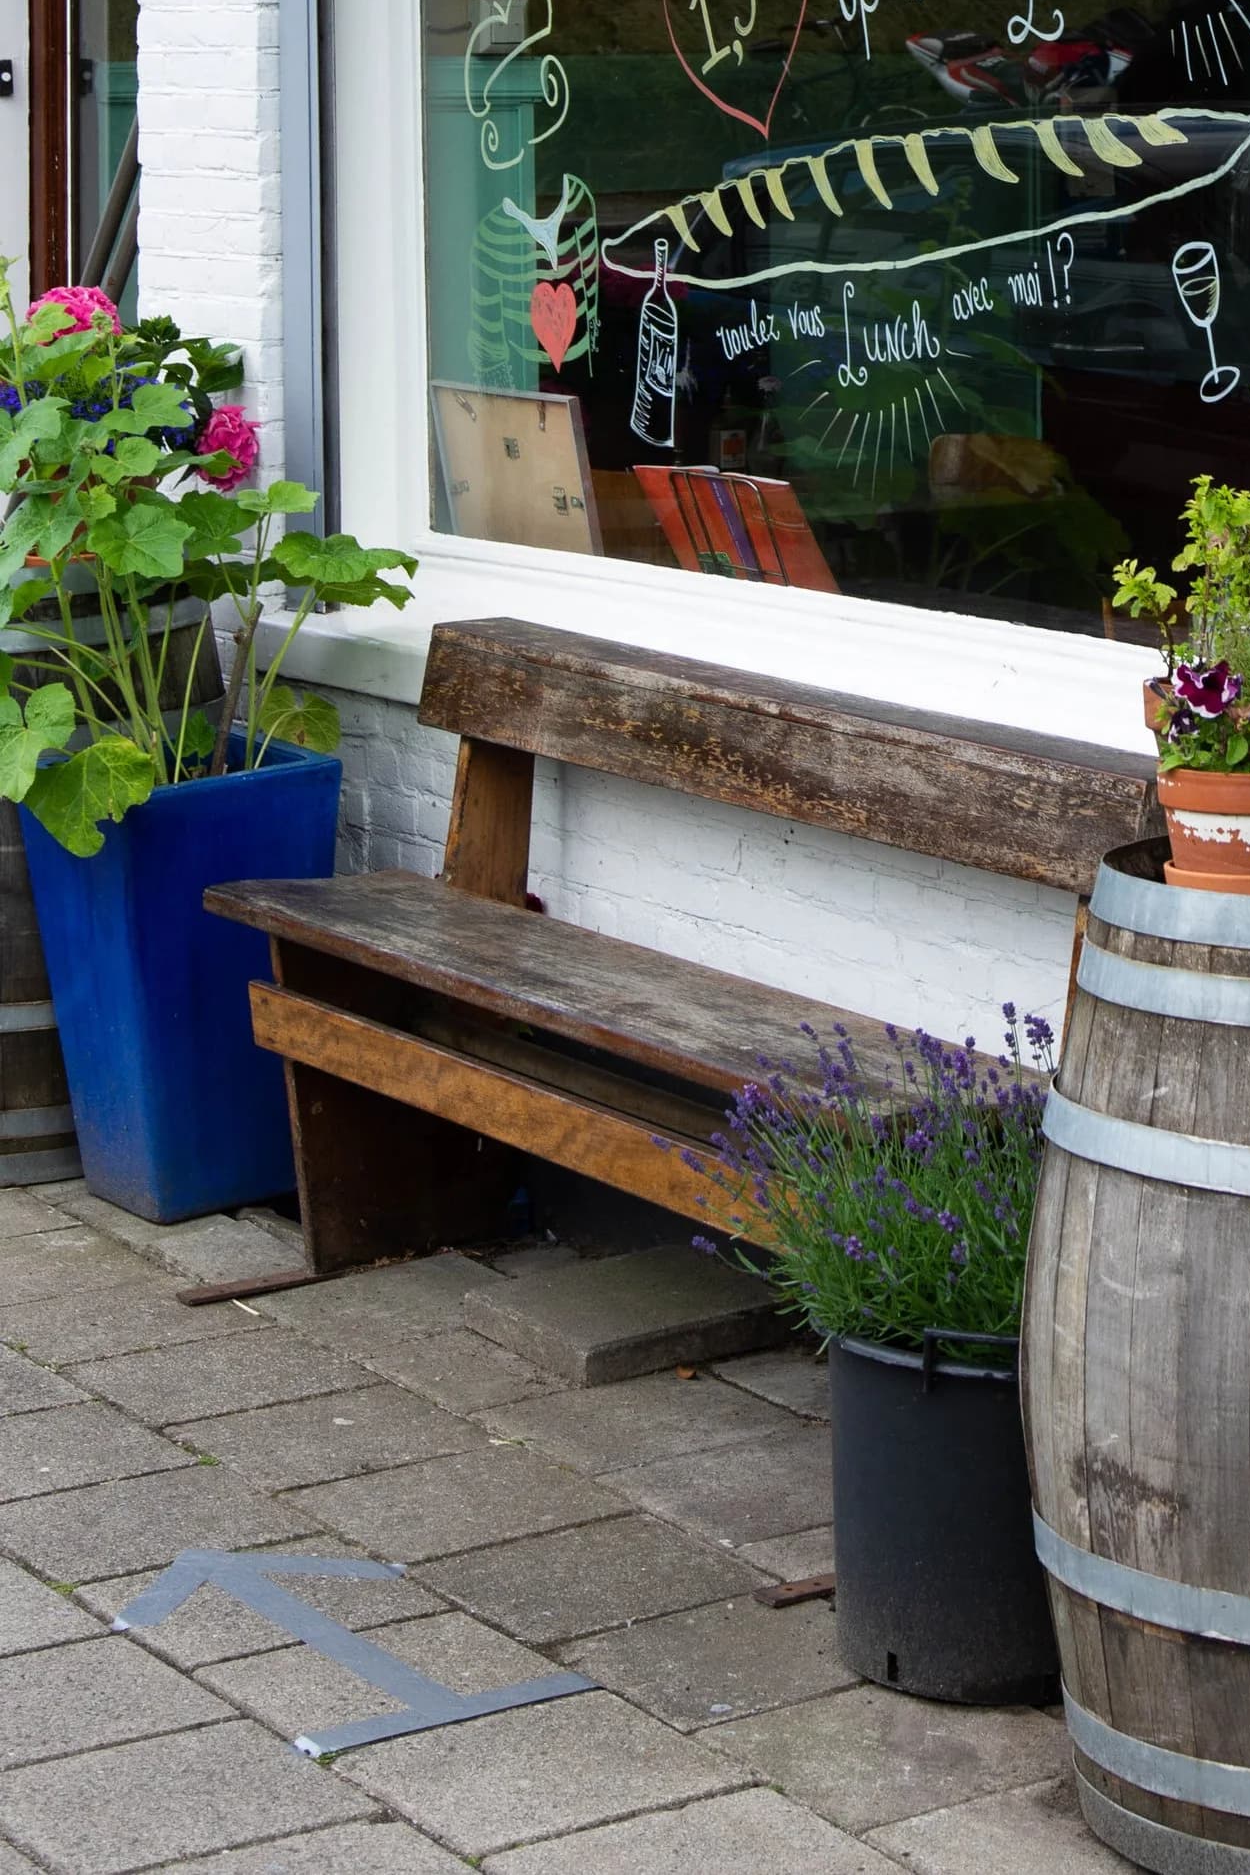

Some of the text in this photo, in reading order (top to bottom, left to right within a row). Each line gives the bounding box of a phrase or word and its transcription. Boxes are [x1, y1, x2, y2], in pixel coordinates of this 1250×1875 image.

[716, 299, 780, 361] voulez
[787, 301, 825, 340] vous
[952, 277, 994, 321] avec
